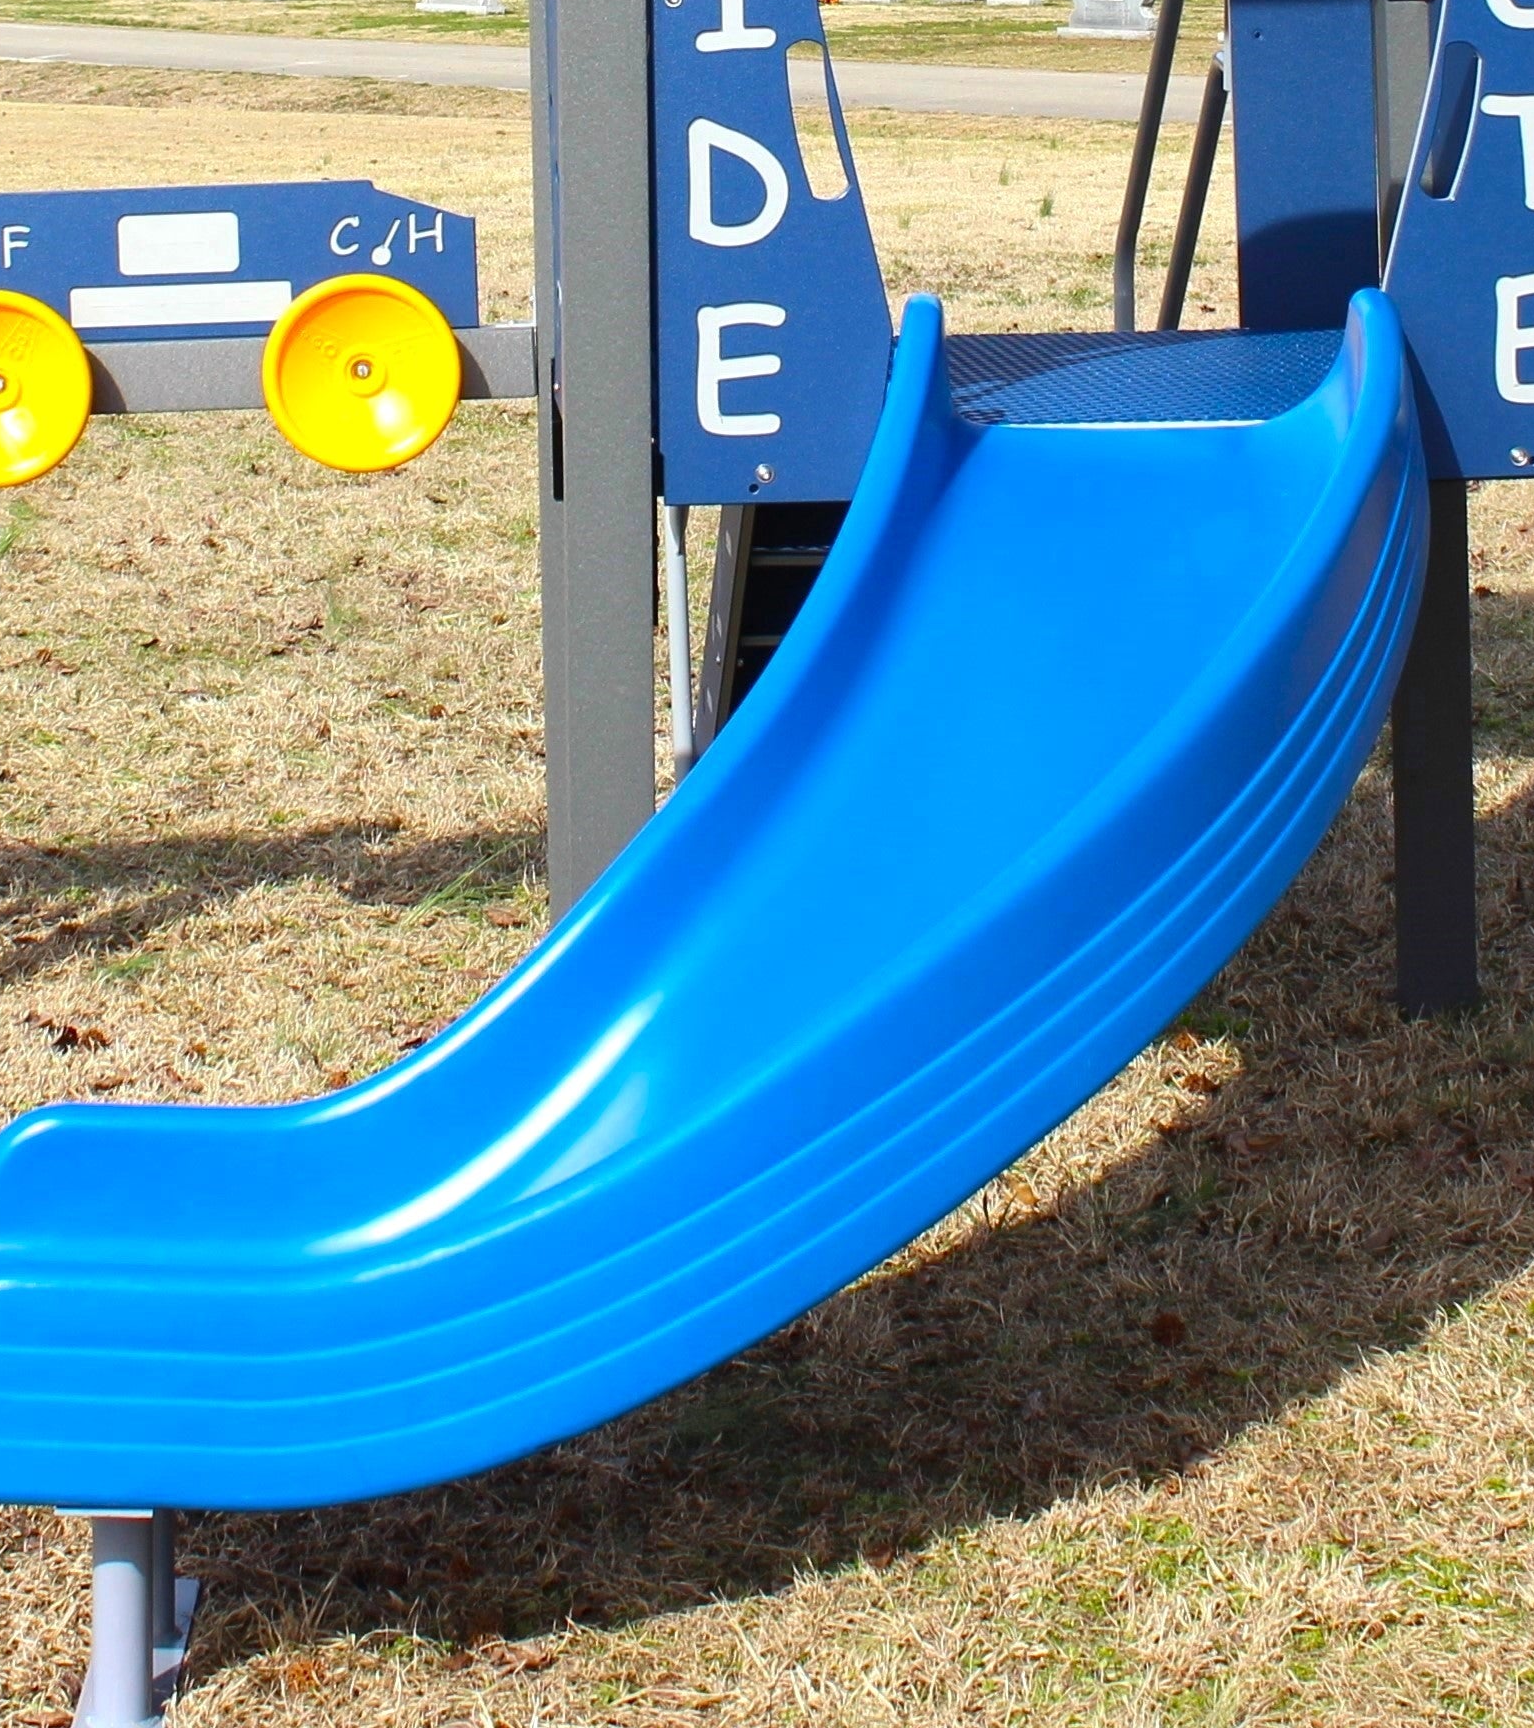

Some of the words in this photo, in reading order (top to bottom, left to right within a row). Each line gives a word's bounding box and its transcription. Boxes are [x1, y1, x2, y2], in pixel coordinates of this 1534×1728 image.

[2, 225, 31, 269] F
[329, 215, 360, 256] C
[408, 212, 444, 254] H
